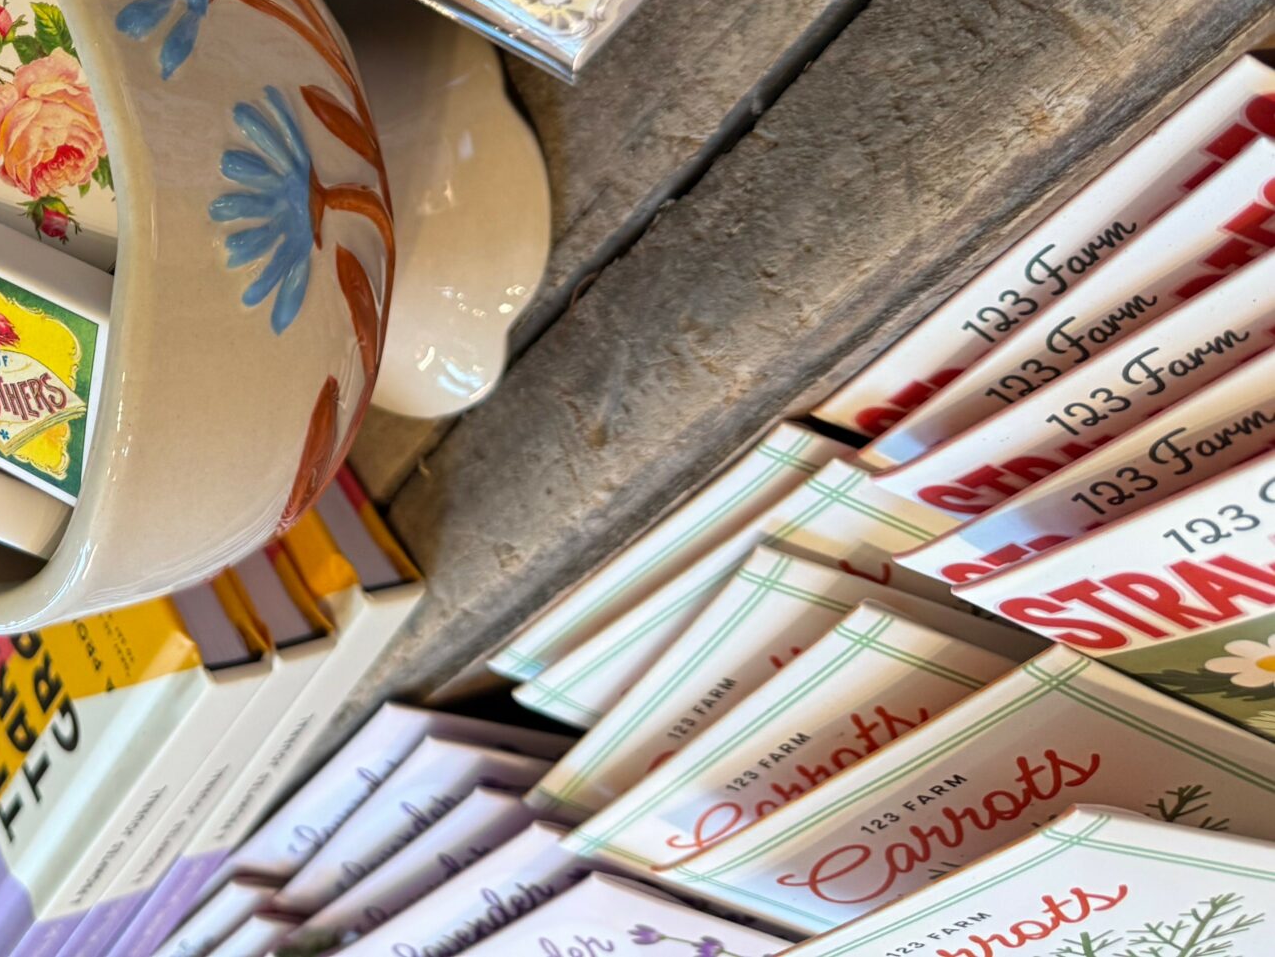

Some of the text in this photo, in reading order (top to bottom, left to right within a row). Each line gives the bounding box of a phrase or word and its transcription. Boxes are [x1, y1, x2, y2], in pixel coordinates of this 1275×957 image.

[962, 290, 1038, 344] 123
[1024, 223, 1137, 296] Farm
[985, 358, 1062, 406] 123
[1046, 295, 1158, 363] Farm
[1045, 329, 1250, 436] 123 Farm
[1071, 467, 1159, 515] 123
[1148, 410, 1275, 476] Farm
[1163, 504, 1261, 553] 123
[667, 676, 738, 740] 123 FARM
[725, 731, 812, 792] 123 FARM
[776, 749, 1100, 904] Carrots
[860, 773, 968, 835] 123 FARM
[886, 911, 992, 957] 123 FARM
